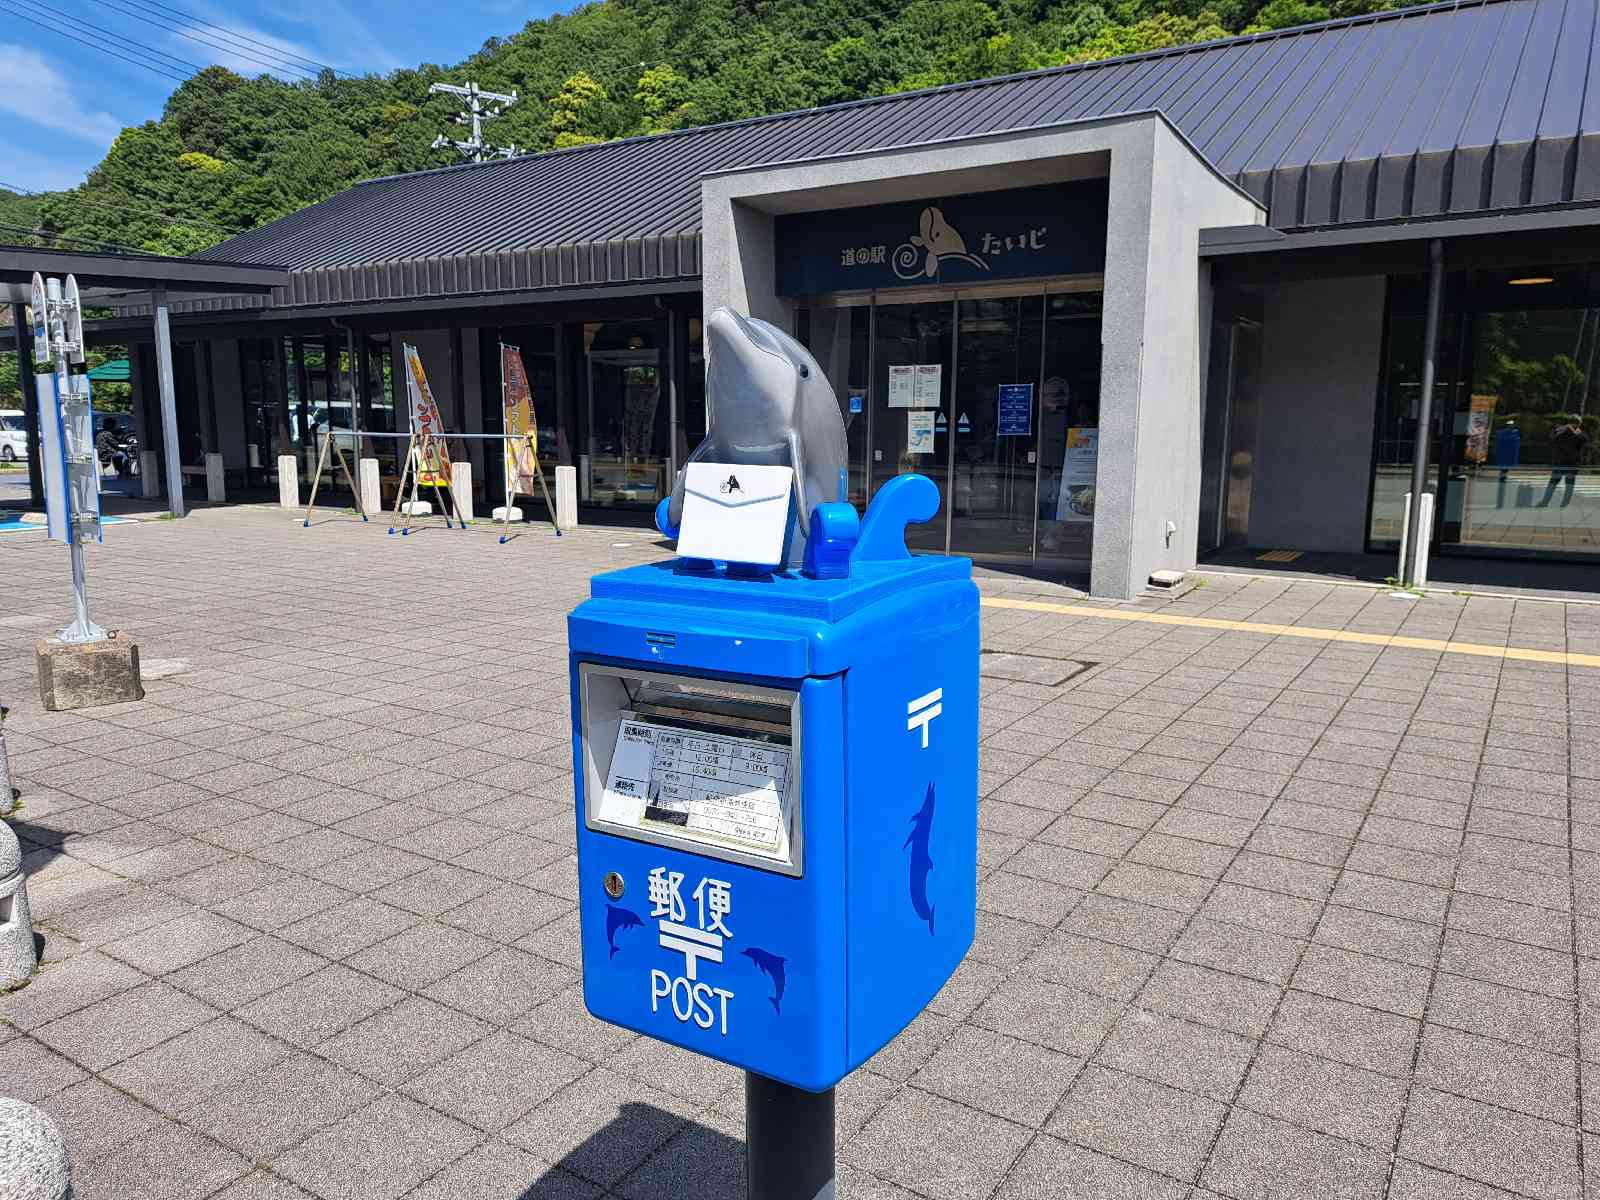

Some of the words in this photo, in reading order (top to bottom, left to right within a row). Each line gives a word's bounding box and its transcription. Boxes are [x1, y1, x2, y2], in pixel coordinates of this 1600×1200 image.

[841, 246, 886, 266] 道の駅
[981, 227, 1048, 255] たいじ
[648, 866, 734, 938] 郵便
[651, 968, 735, 1035] POST
